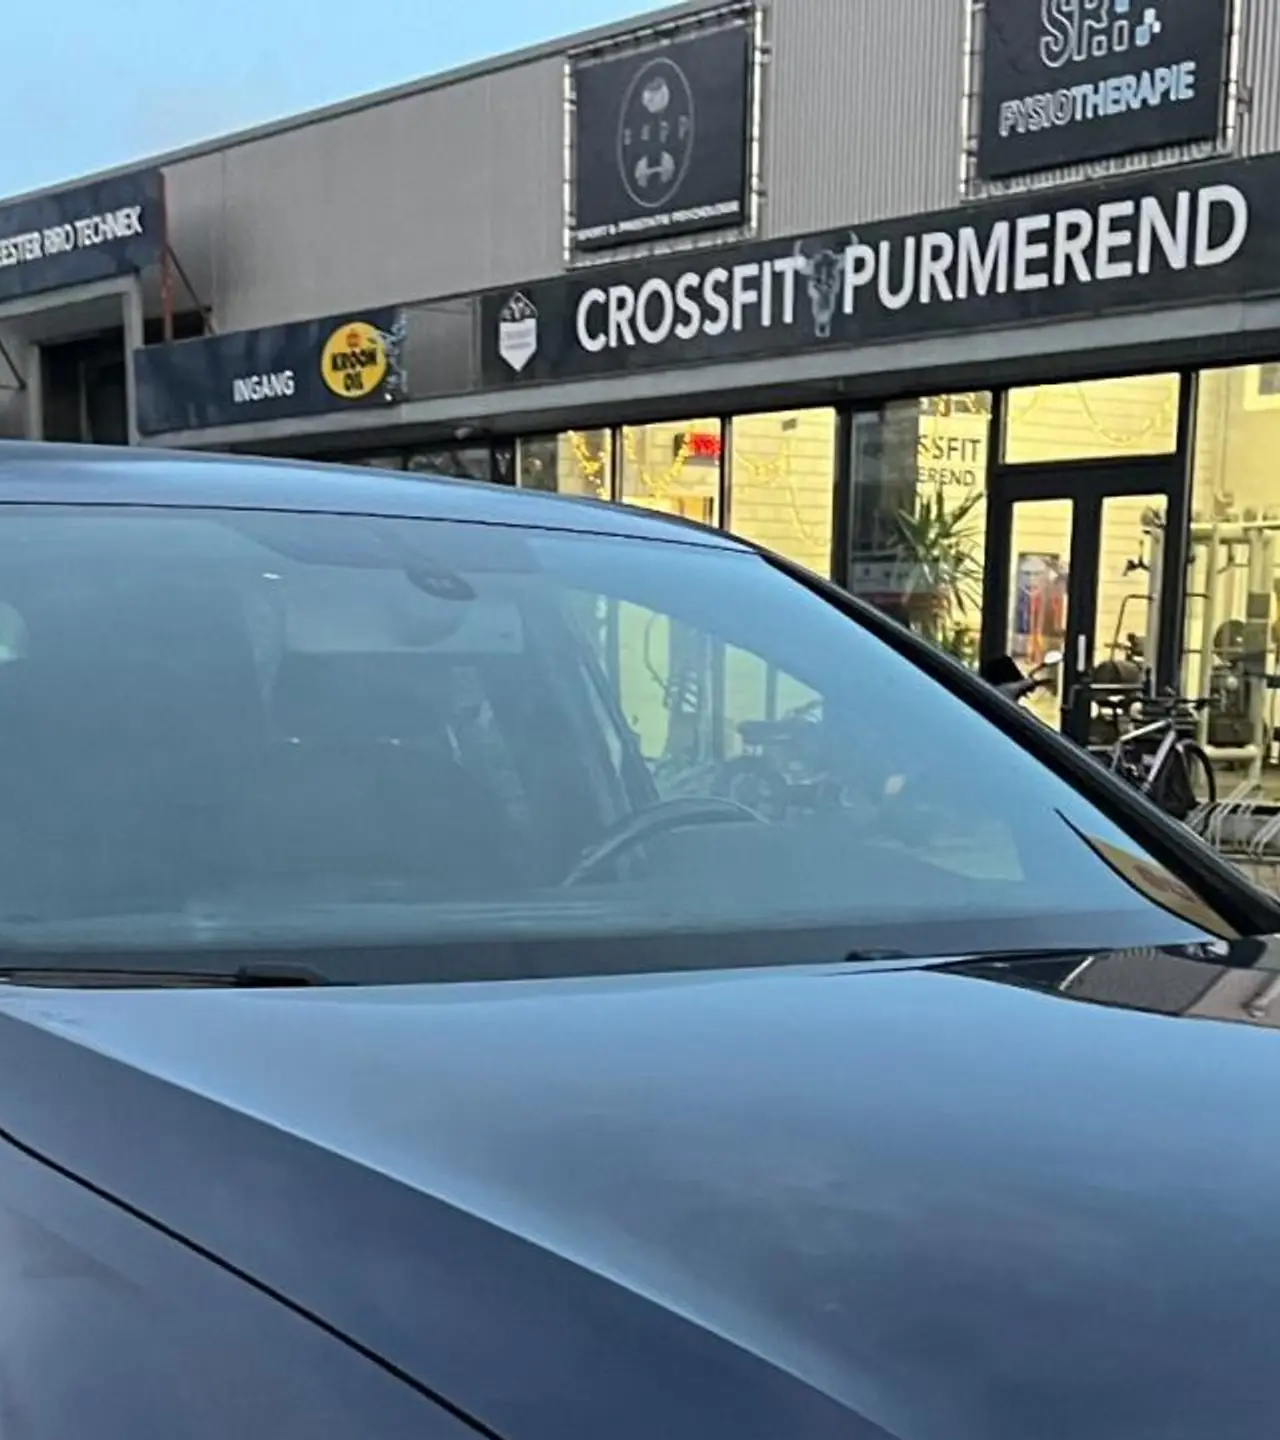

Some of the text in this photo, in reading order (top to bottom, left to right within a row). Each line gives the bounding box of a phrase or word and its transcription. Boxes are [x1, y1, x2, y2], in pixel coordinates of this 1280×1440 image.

[999, 61, 1196, 137] FYSIOTHERAPIE
[75, 205, 144, 249] TECHNIEK
[576, 184, 1249, 353] CROSSFIT PURMEREND
[233, 370, 295, 402] INGANG
